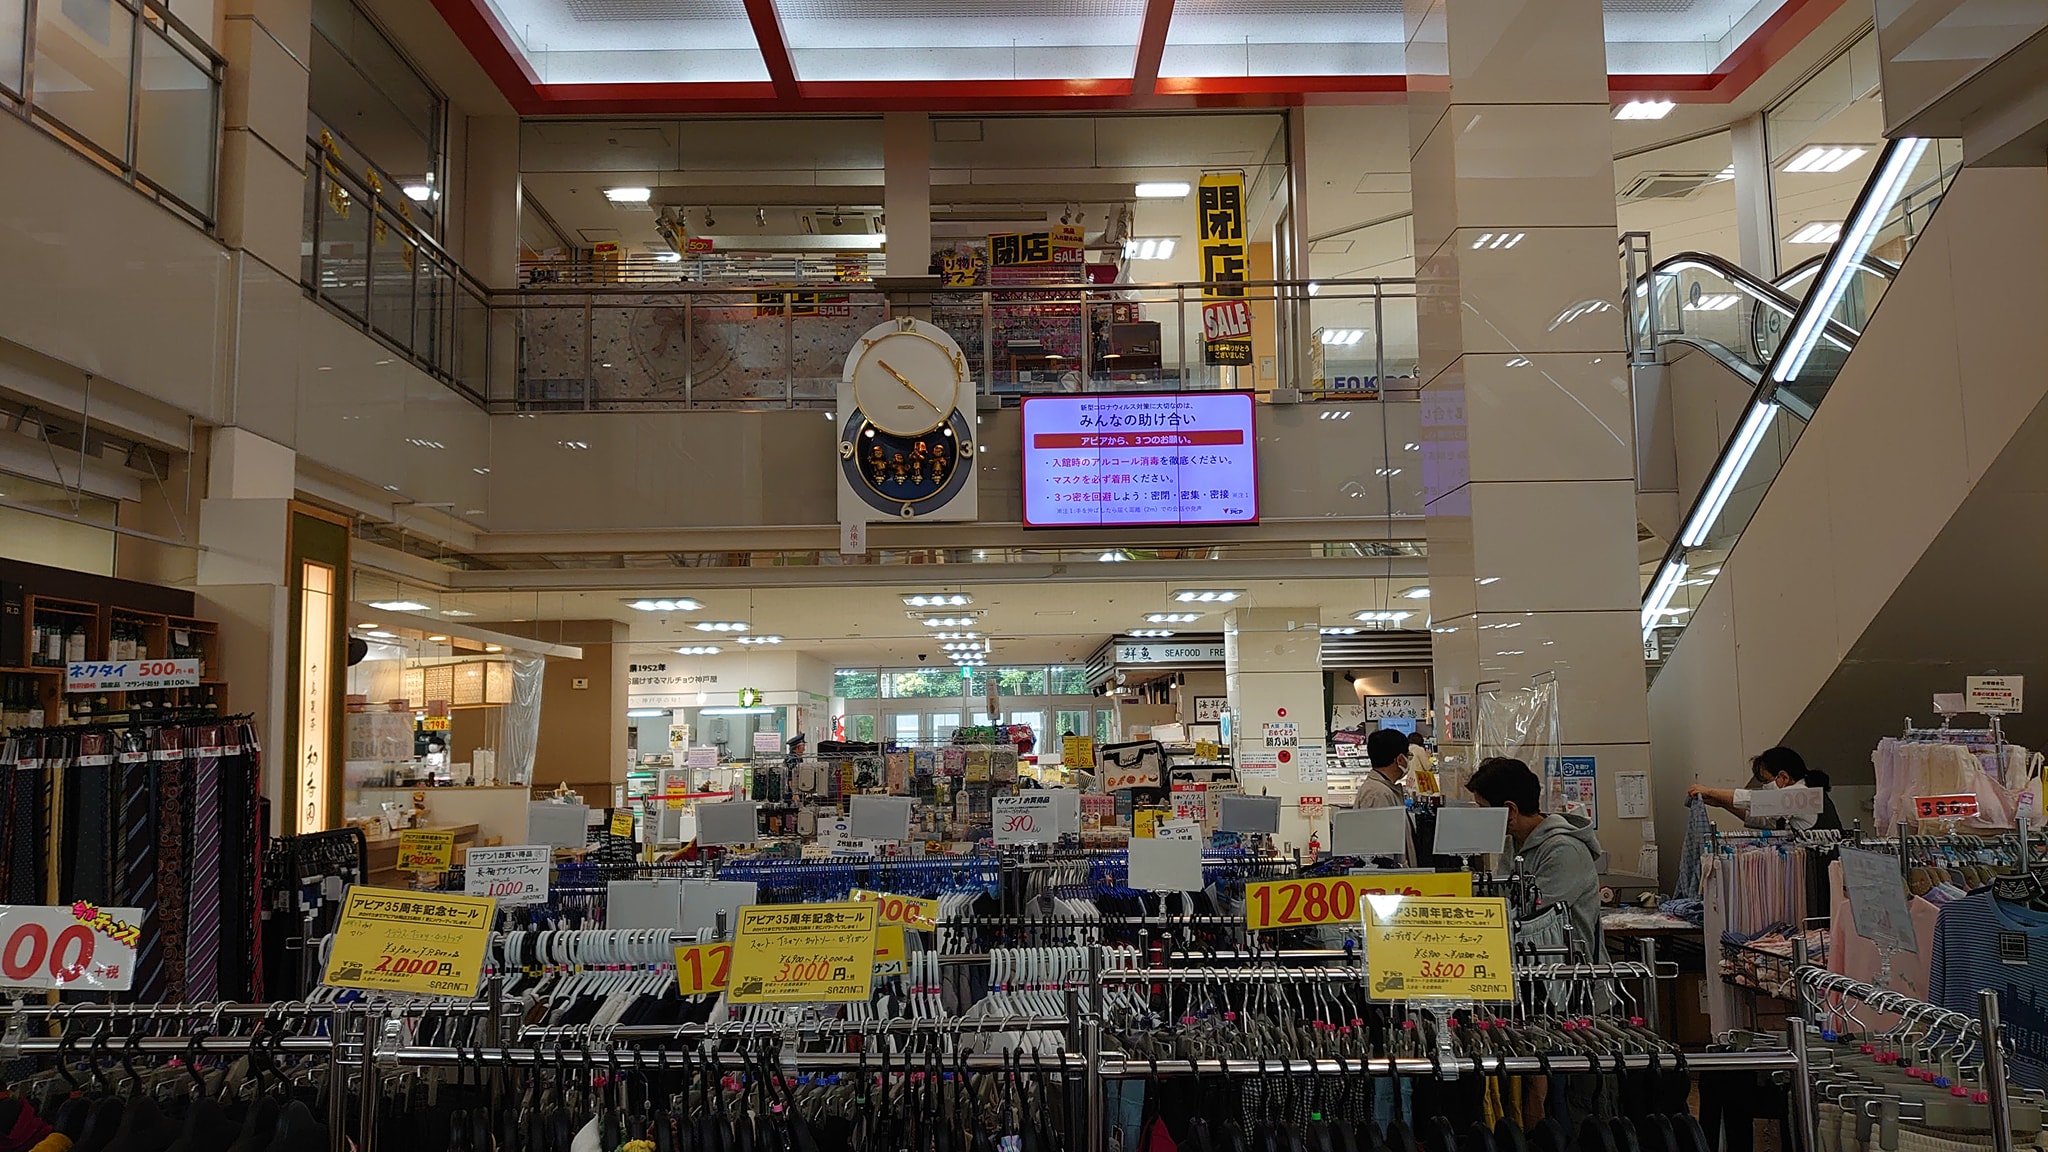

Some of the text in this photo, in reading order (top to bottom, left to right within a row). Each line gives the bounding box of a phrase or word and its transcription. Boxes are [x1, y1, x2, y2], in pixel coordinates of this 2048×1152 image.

[992, 233, 1049, 265] 閉店
[1199, 185, 1244, 296] 閉店
[1054, 251, 1083, 263] SALE
[819, 305, 848, 316] SALE
[896, 316, 917, 333] 12
[1204, 303, 1249, 339] SALE
[1079, 412, 1196, 428] みんなの助け合い
[839, 441, 854, 460] 9
[960, 440, 973, 459] 3
[899, 501, 915, 519] 6
[1123, 646, 1225, 660] 鮮魚 SEAFOOD FRE
[70, 664, 127, 678] ネクタイ
[1001, 814, 1033, 832] 390
[352, 899, 479, 918] アピア35周年記念セール
[1391, 907, 1495, 919] ア35周年記念セール
[72, 900, 141, 949] 今がチャンス
[746, 912, 865, 925] アピア35周年記念セール
